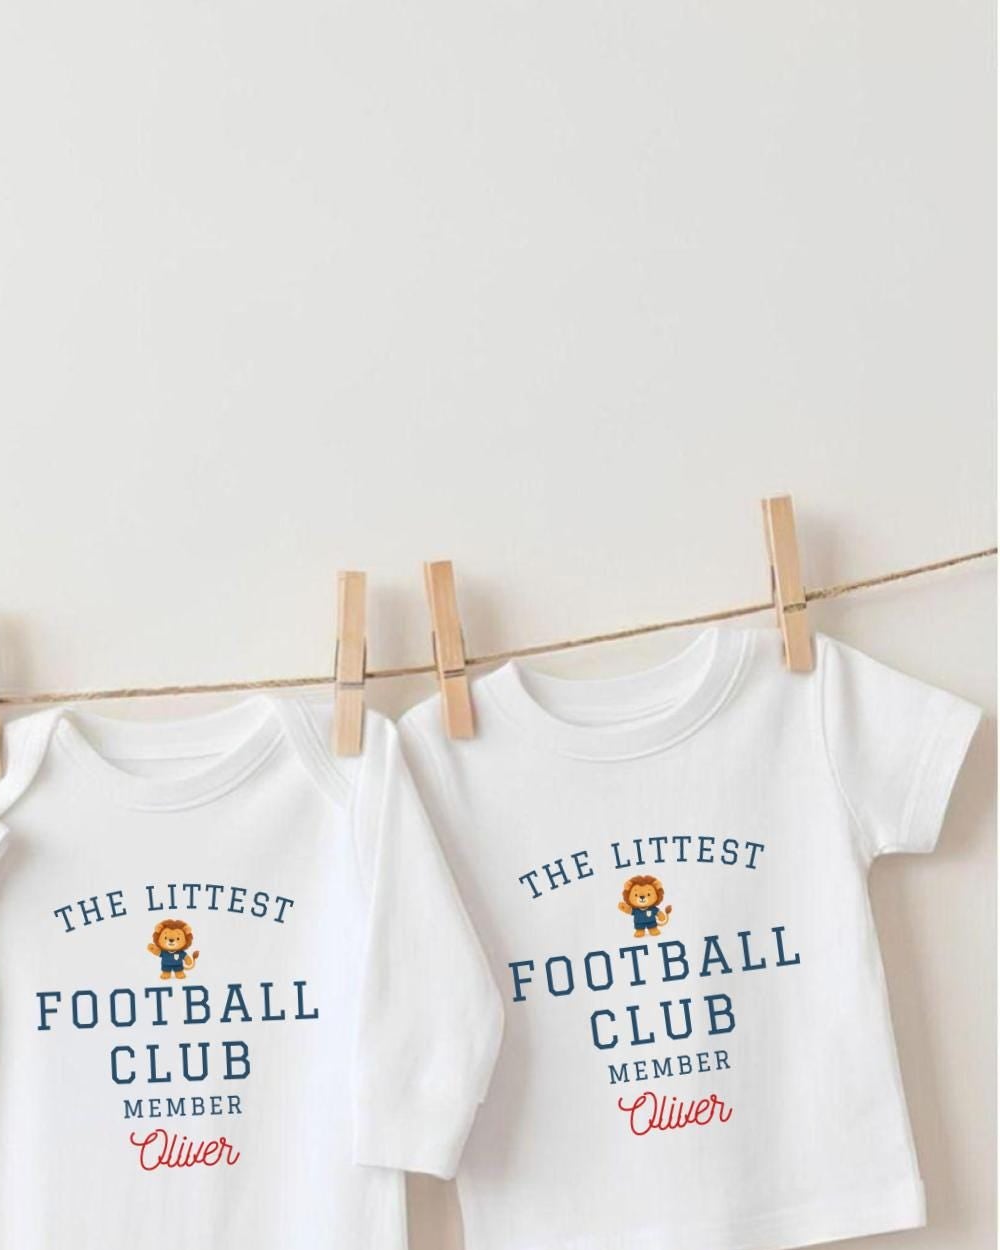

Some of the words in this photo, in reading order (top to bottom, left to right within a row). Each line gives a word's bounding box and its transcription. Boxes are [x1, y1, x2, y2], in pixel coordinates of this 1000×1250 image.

[519, 851, 594, 899] THE
[611, 836, 765, 870] LITTEST
[54, 890, 127, 932] THE
[146, 883, 294, 923] LITTEST
[508, 926, 800, 1003] FOOTBALL
[36, 981, 319, 1031] FOOTBALL
[590, 993, 736, 1050] CLUB
[111, 1040, 250, 1085] CLUB
[608, 1050, 730, 1084] MEMBER
[123, 1095, 242, 1119] MEMBER
[617, 1091, 732, 1136] Oliver
[129, 1128, 240, 1171] Oliver
